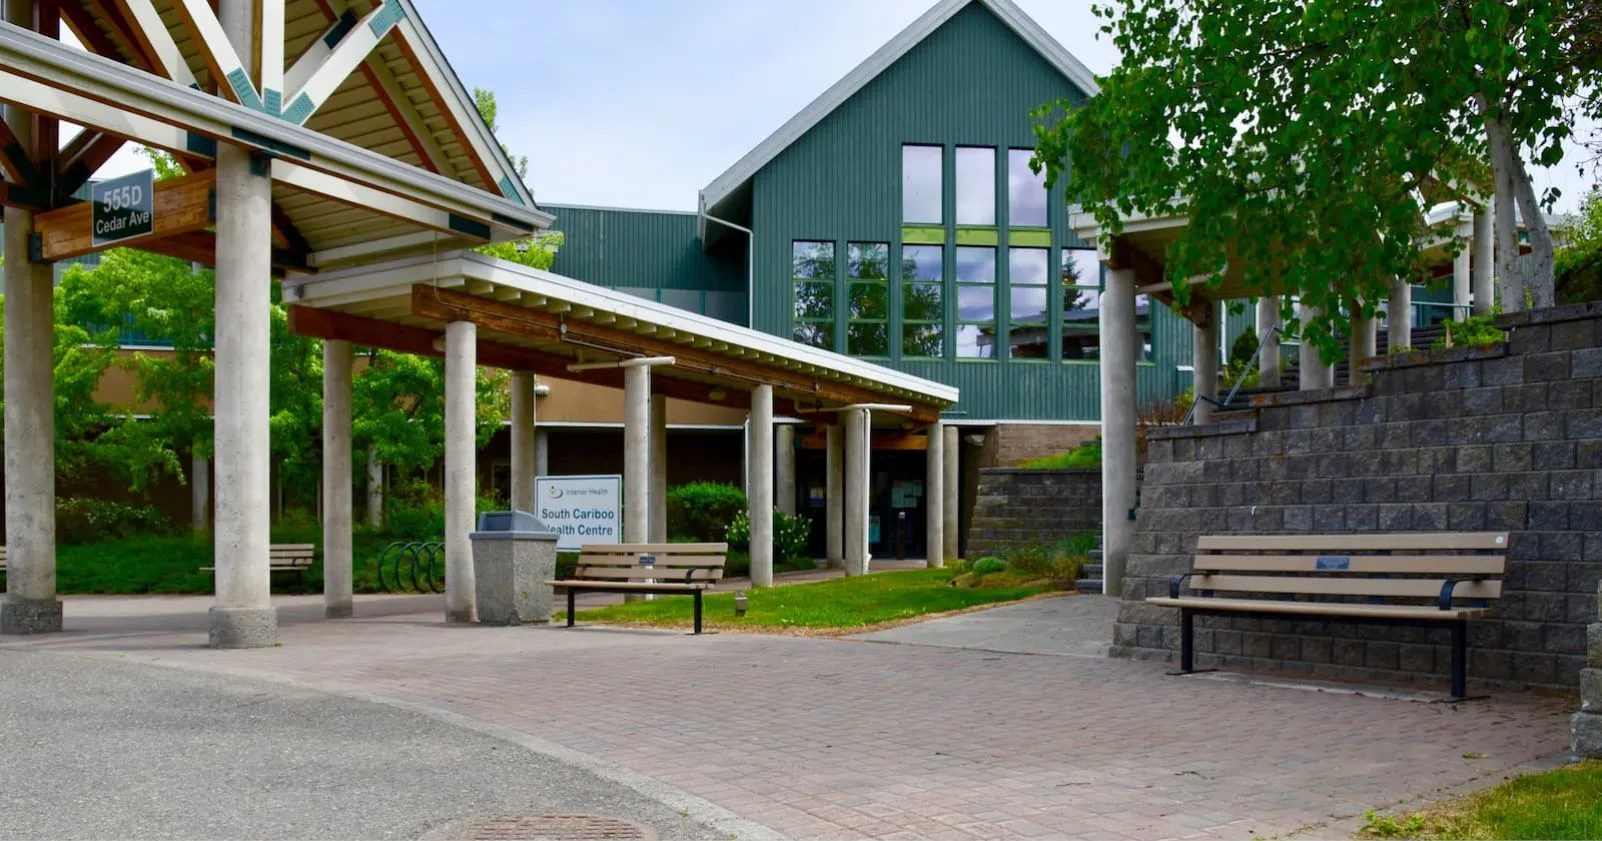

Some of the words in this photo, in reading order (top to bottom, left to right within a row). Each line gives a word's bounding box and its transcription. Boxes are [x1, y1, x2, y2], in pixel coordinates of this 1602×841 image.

[103, 185, 142, 213] 555D
[96, 215, 128, 234] Cedar
[128, 211, 149, 227] Ave
[541, 508, 571, 520] South
[573, 508, 615, 520] Cariboo
[547, 524, 576, 536] ealth
[577, 524, 613, 536] Centre
